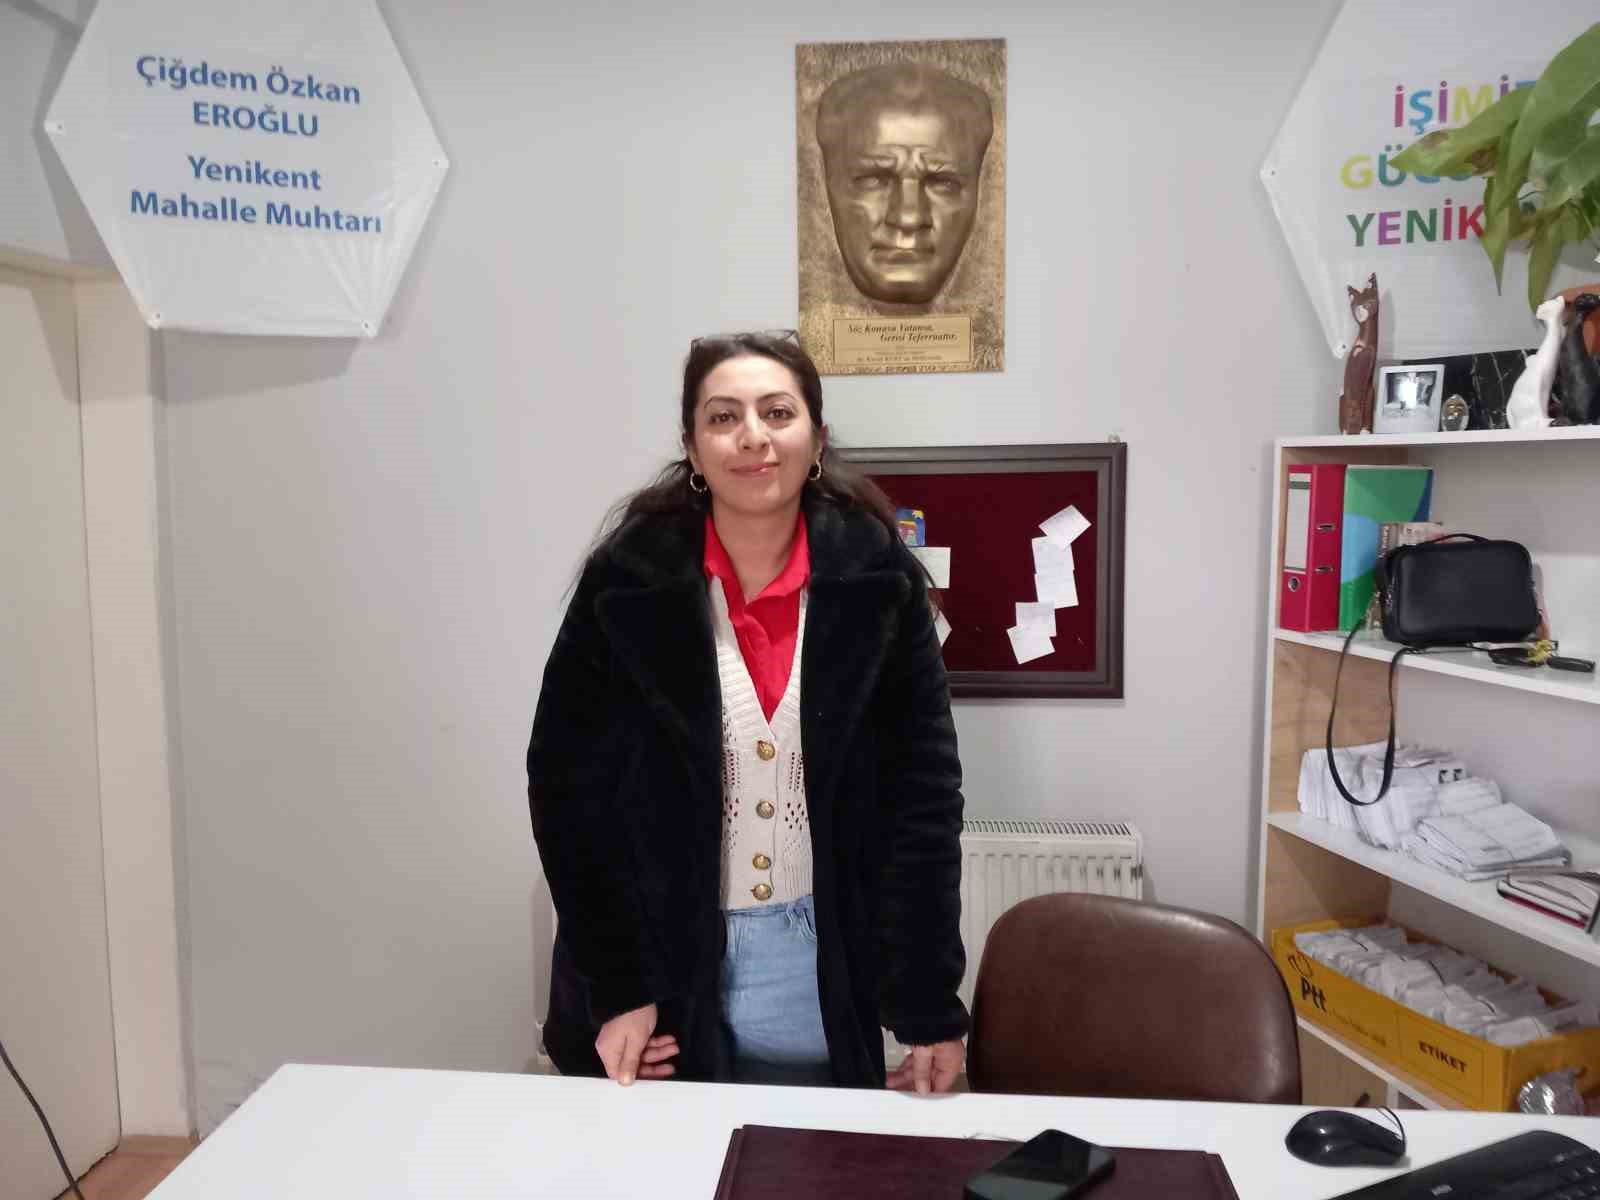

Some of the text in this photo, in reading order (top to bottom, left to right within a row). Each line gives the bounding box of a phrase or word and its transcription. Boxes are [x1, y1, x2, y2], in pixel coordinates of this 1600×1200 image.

[136, 55, 361, 104] Çiğdem Özkan
[193, 101, 320, 137] EROĞLU
[1394, 74, 1538, 136] İŞİM
[188, 155, 322, 191] Yenikent
[130, 190, 383, 234] Mahalle Muhtarı
[1346, 198, 1487, 247] YENİK
